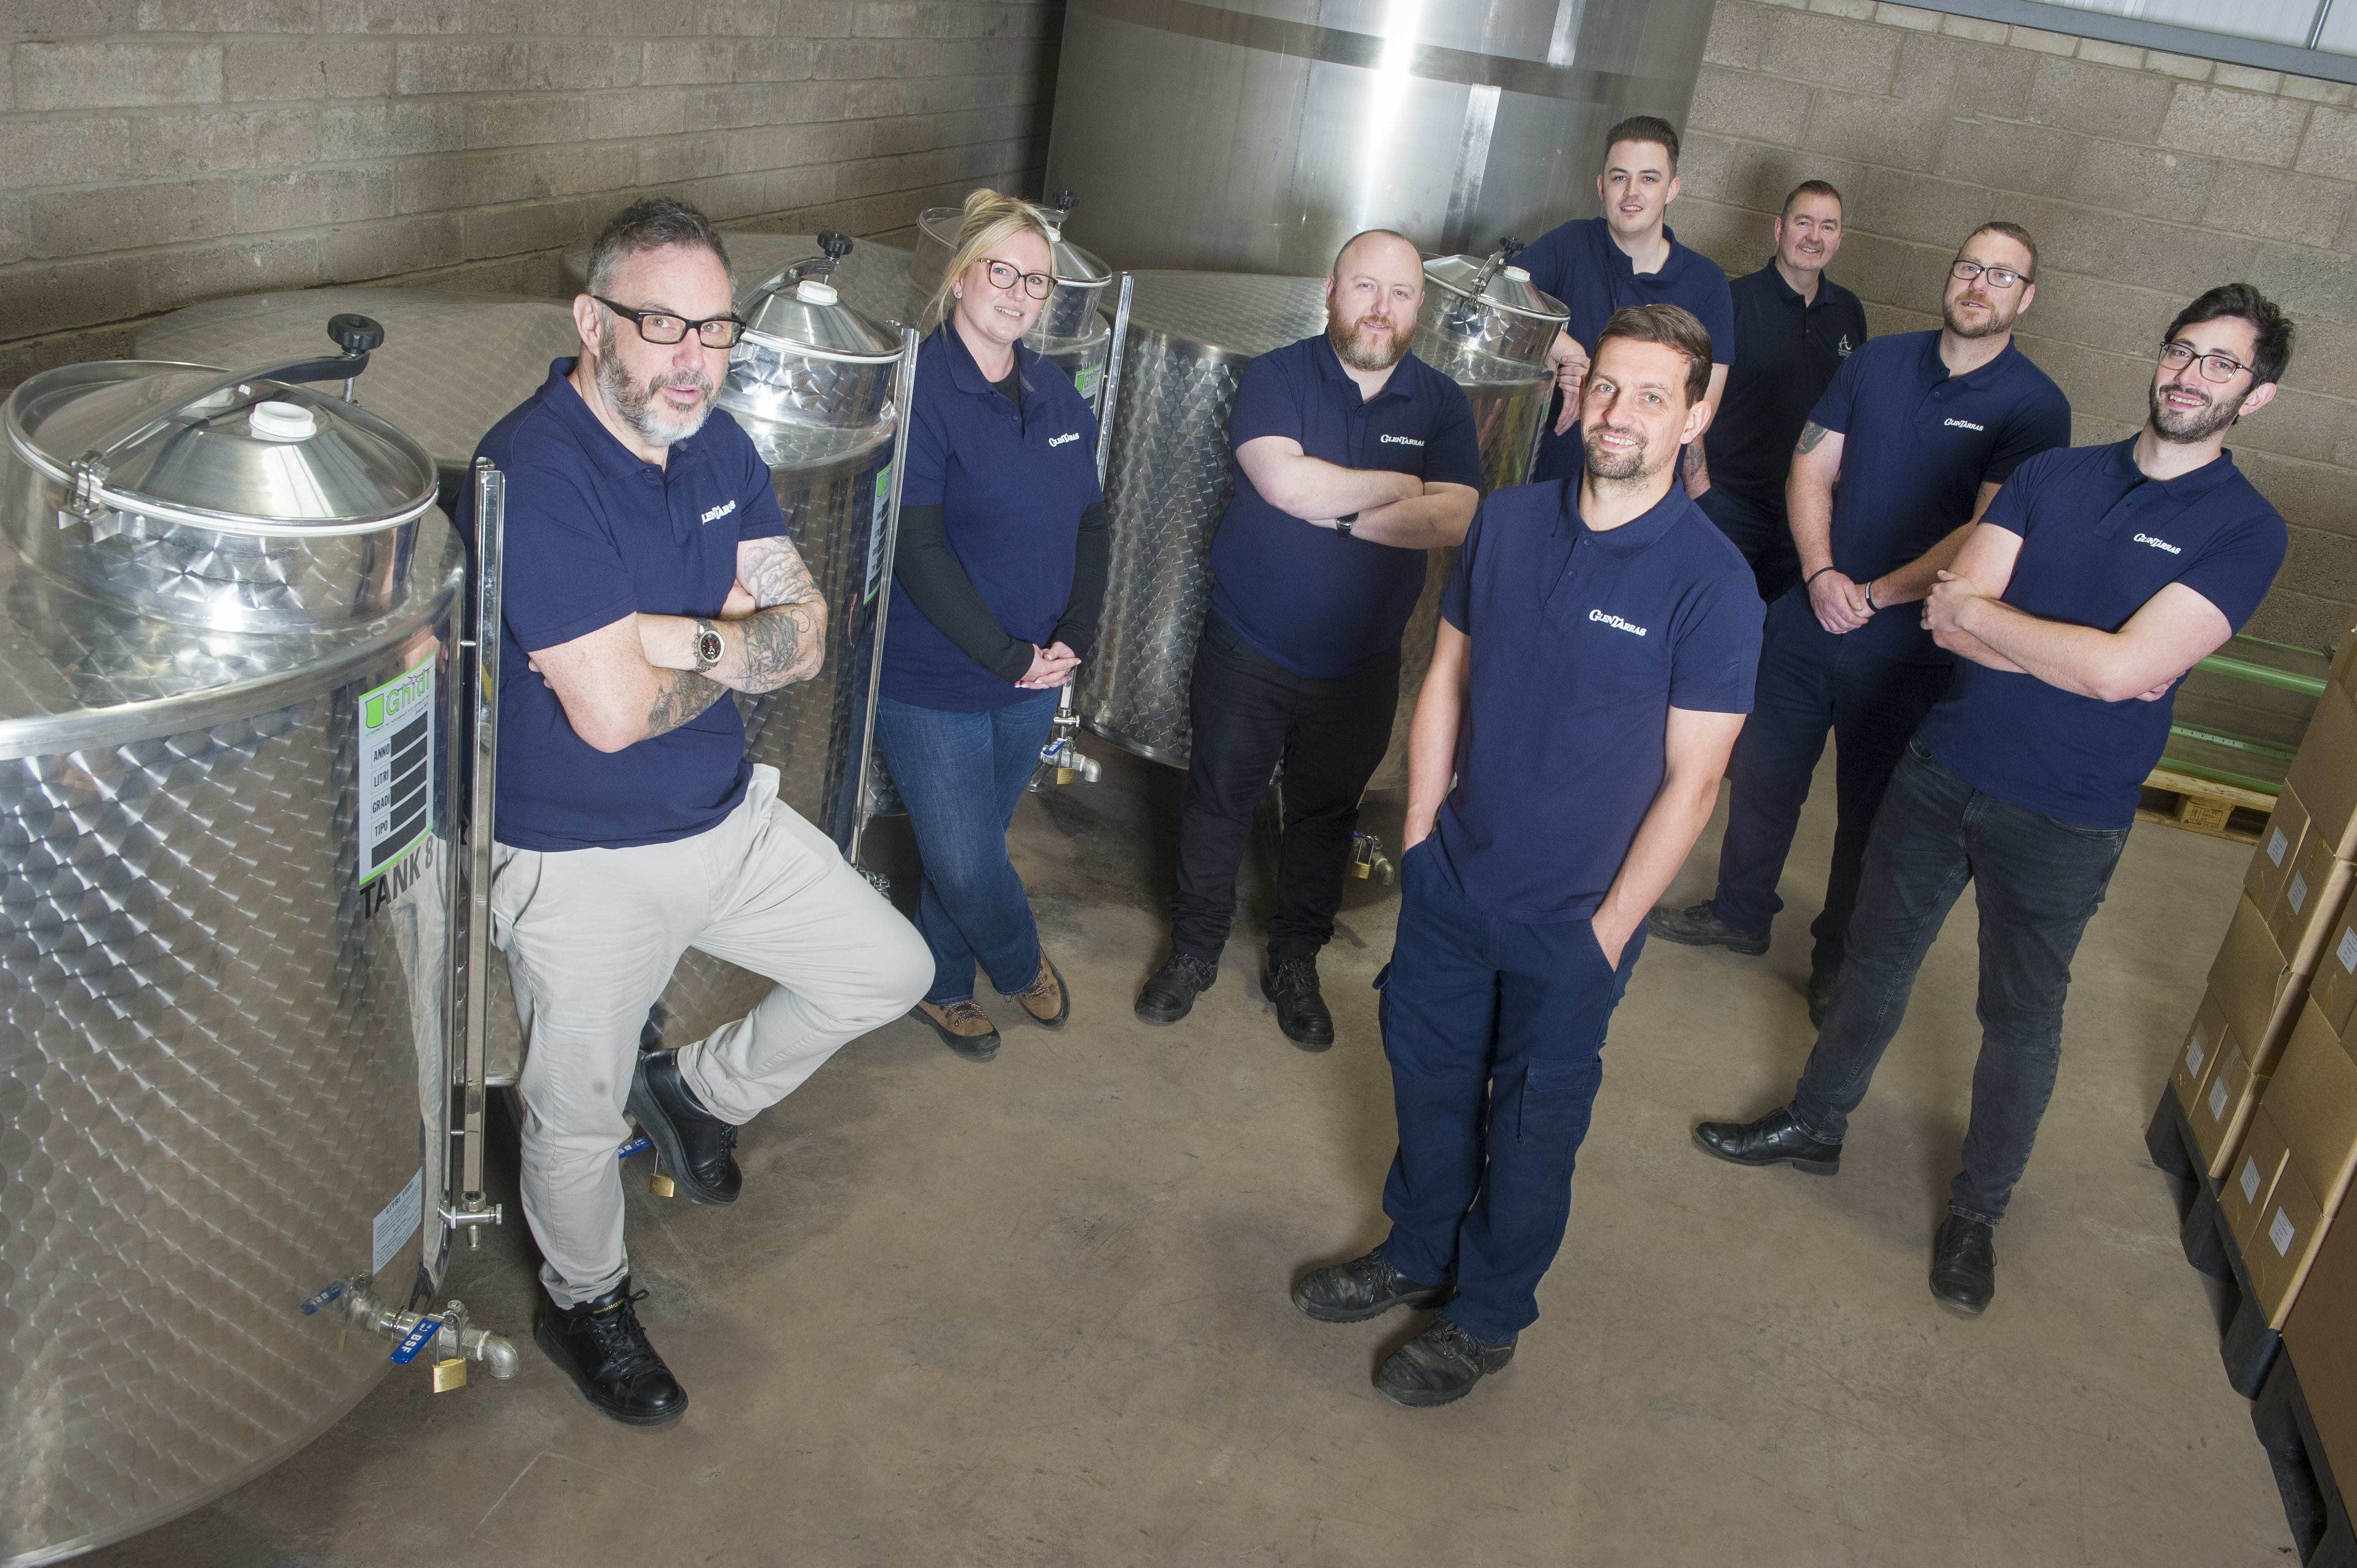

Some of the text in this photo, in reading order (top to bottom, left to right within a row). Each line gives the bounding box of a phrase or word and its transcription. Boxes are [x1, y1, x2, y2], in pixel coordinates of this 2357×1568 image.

[386, 669, 430, 715] Ghidi
[374, 743, 390, 762] ANNO
[374, 769, 389, 787] LITRI
[373, 793, 390, 813] GRADI
[374, 820, 388, 837] TIPO
[360, 834, 434, 920] TANK 8
[386, 1195, 400, 1214] LITRI
[402, 1181, 413, 1197] 1000
[401, 1334, 423, 1353] BSF
